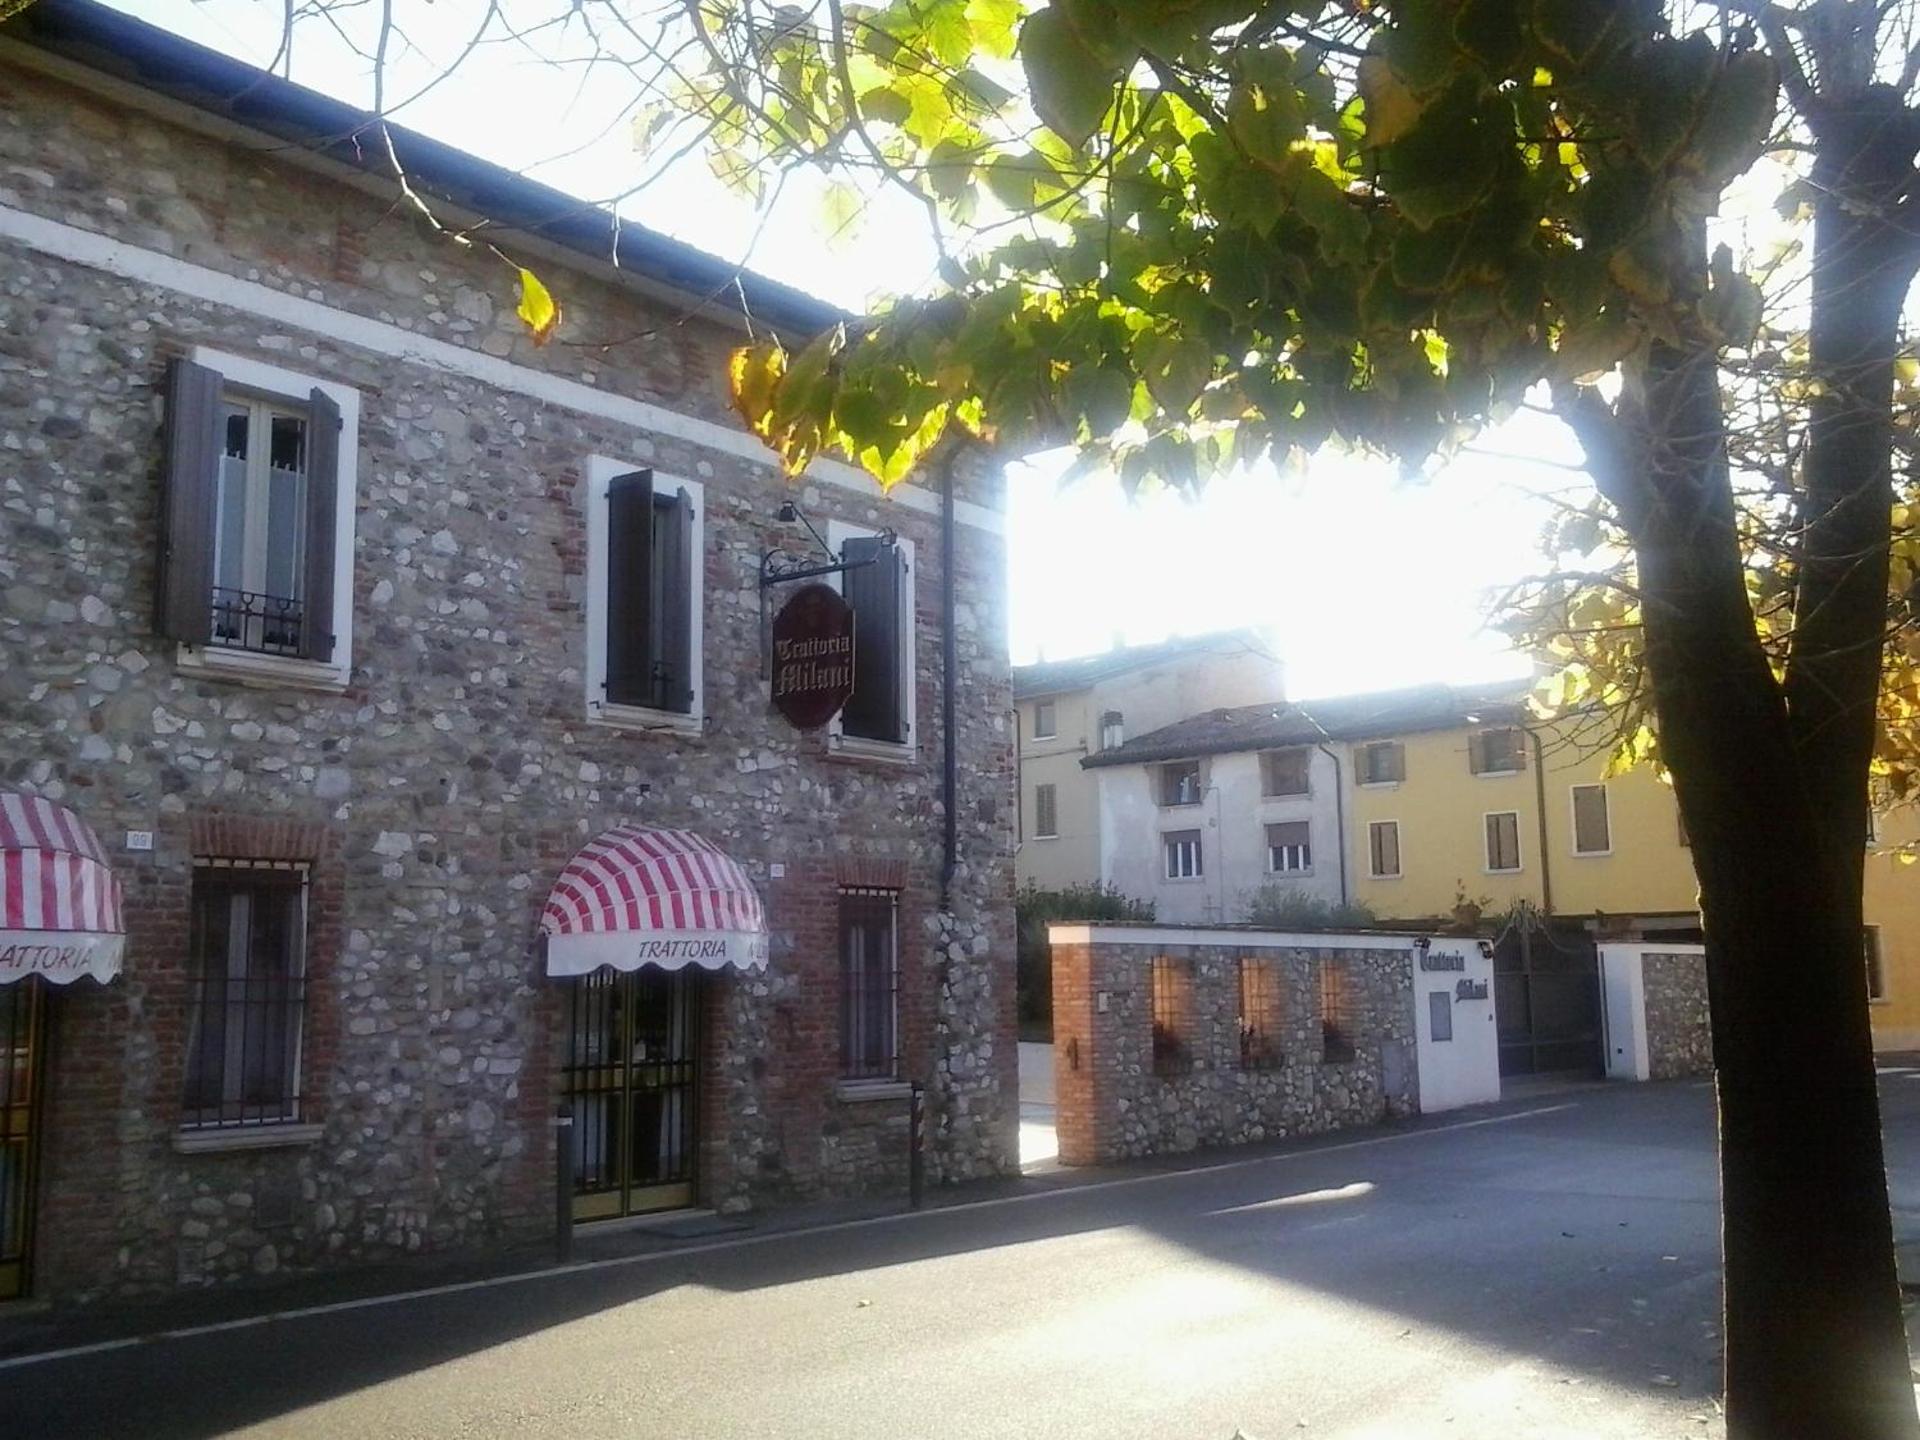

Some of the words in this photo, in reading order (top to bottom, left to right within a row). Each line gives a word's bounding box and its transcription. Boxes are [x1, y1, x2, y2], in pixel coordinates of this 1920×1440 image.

[775, 632, 850, 661] Trattoria
[775, 658, 851, 696] Milani
[0, 944, 94, 970] ATTORIA
[638, 940, 727, 959] TRATTORIA
